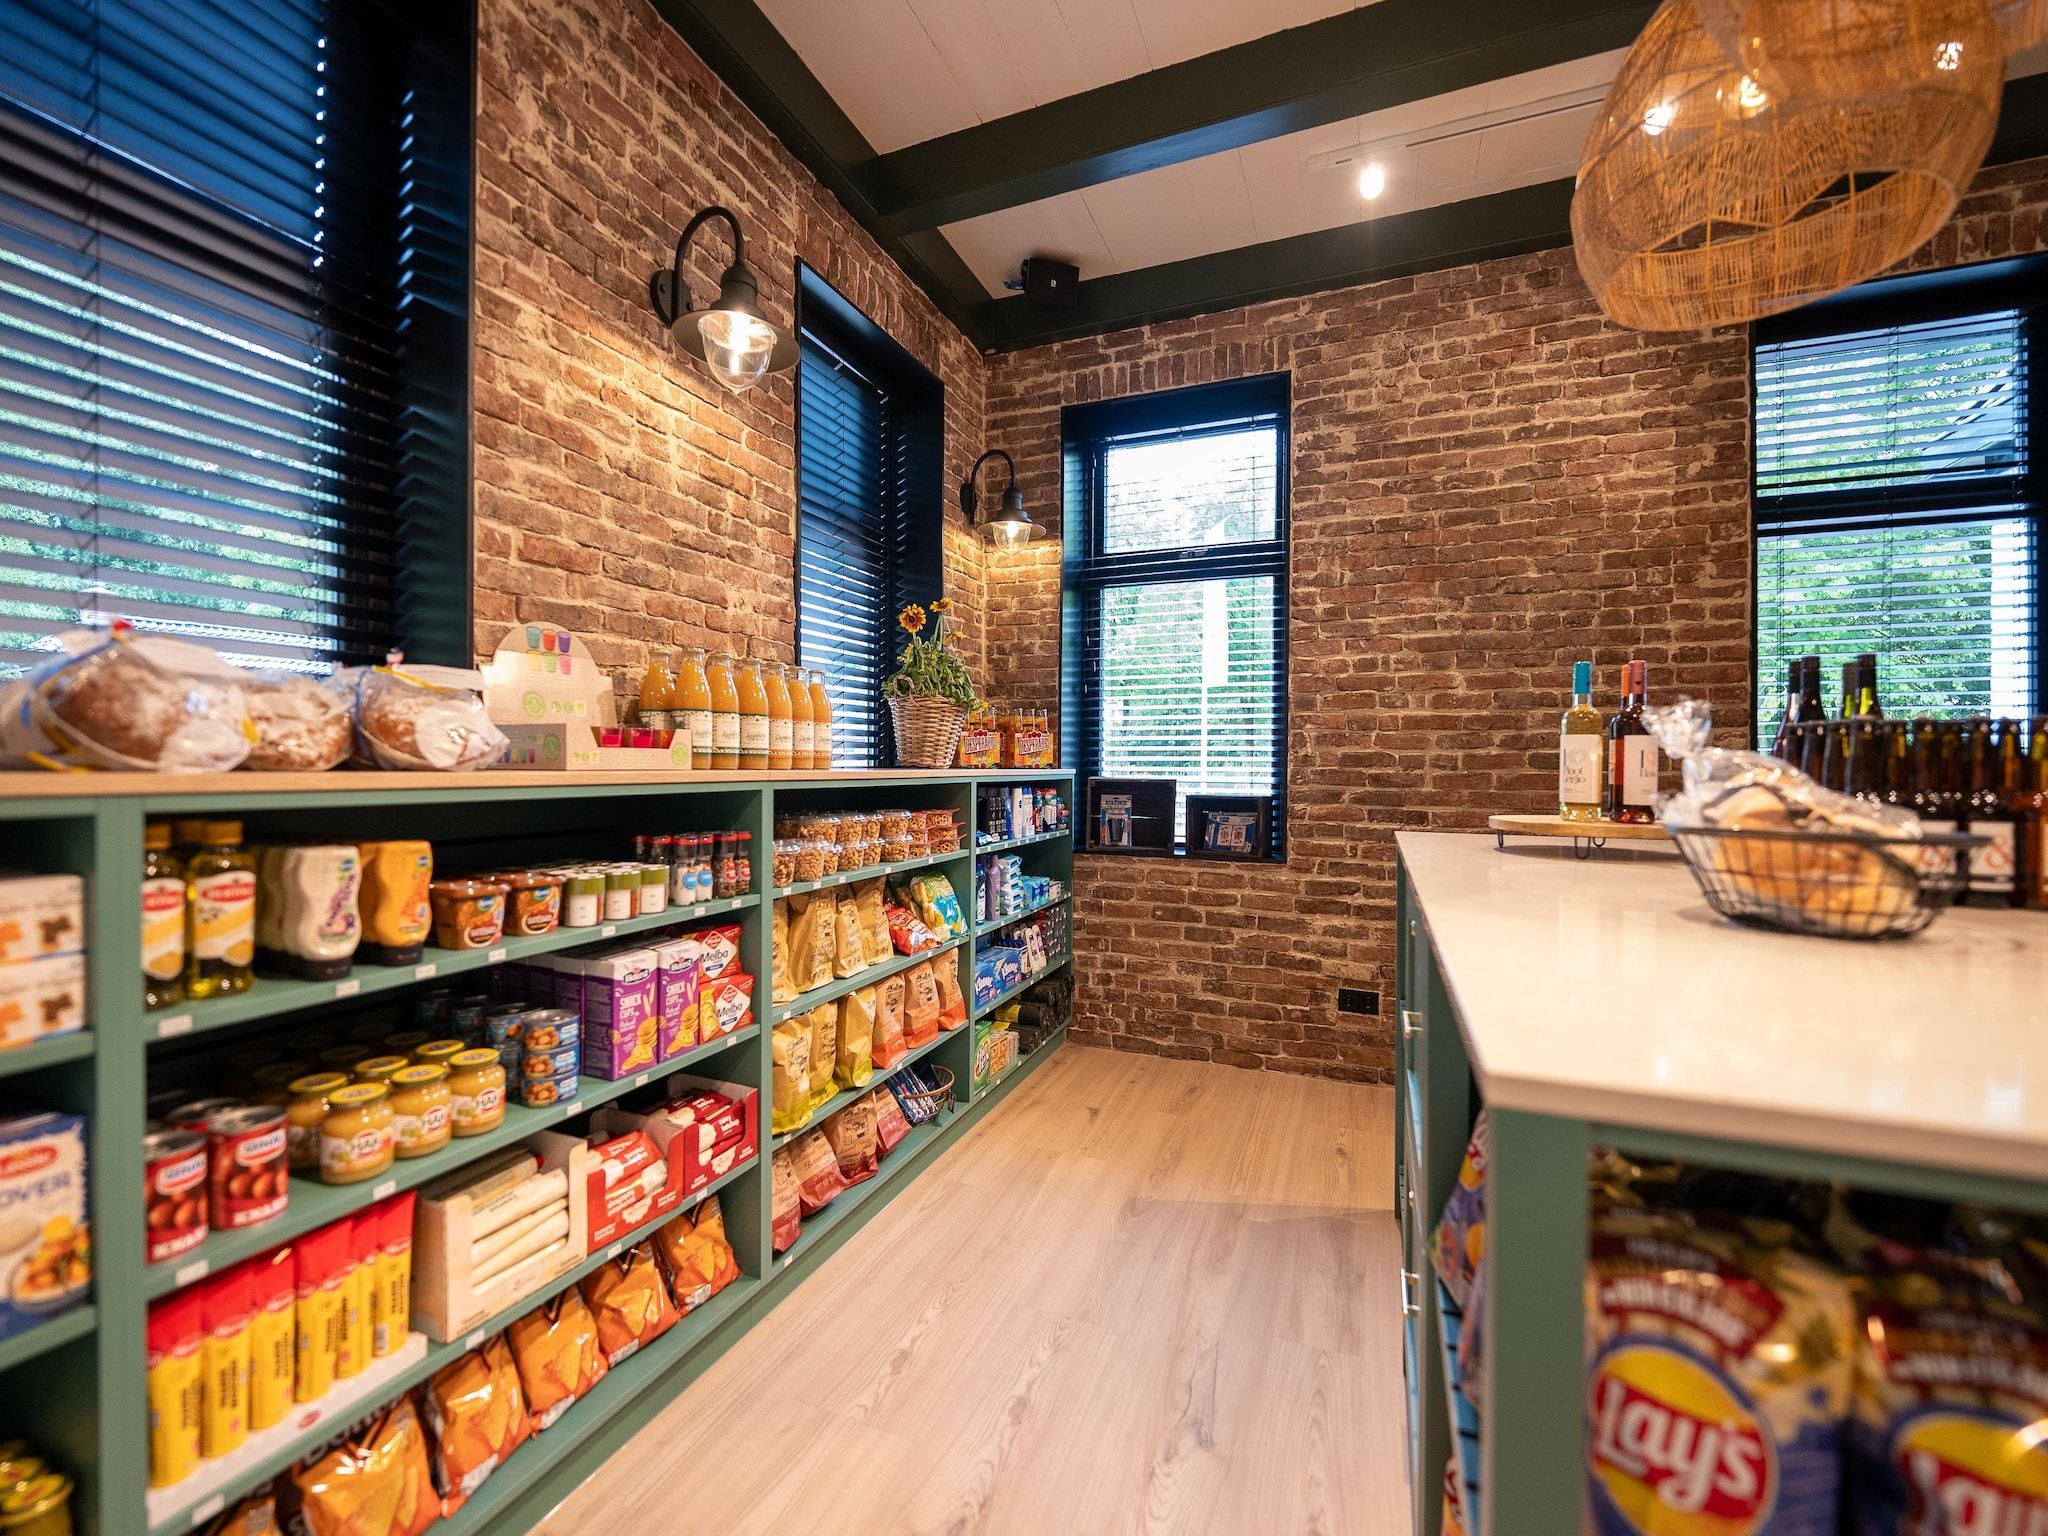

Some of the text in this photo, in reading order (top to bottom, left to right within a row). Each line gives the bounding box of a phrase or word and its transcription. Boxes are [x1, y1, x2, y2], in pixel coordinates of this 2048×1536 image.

[700, 949, 729, 963] Melba
[717, 1002, 743, 1018] Melba
[1597, 1380, 1762, 1512] Lay's
